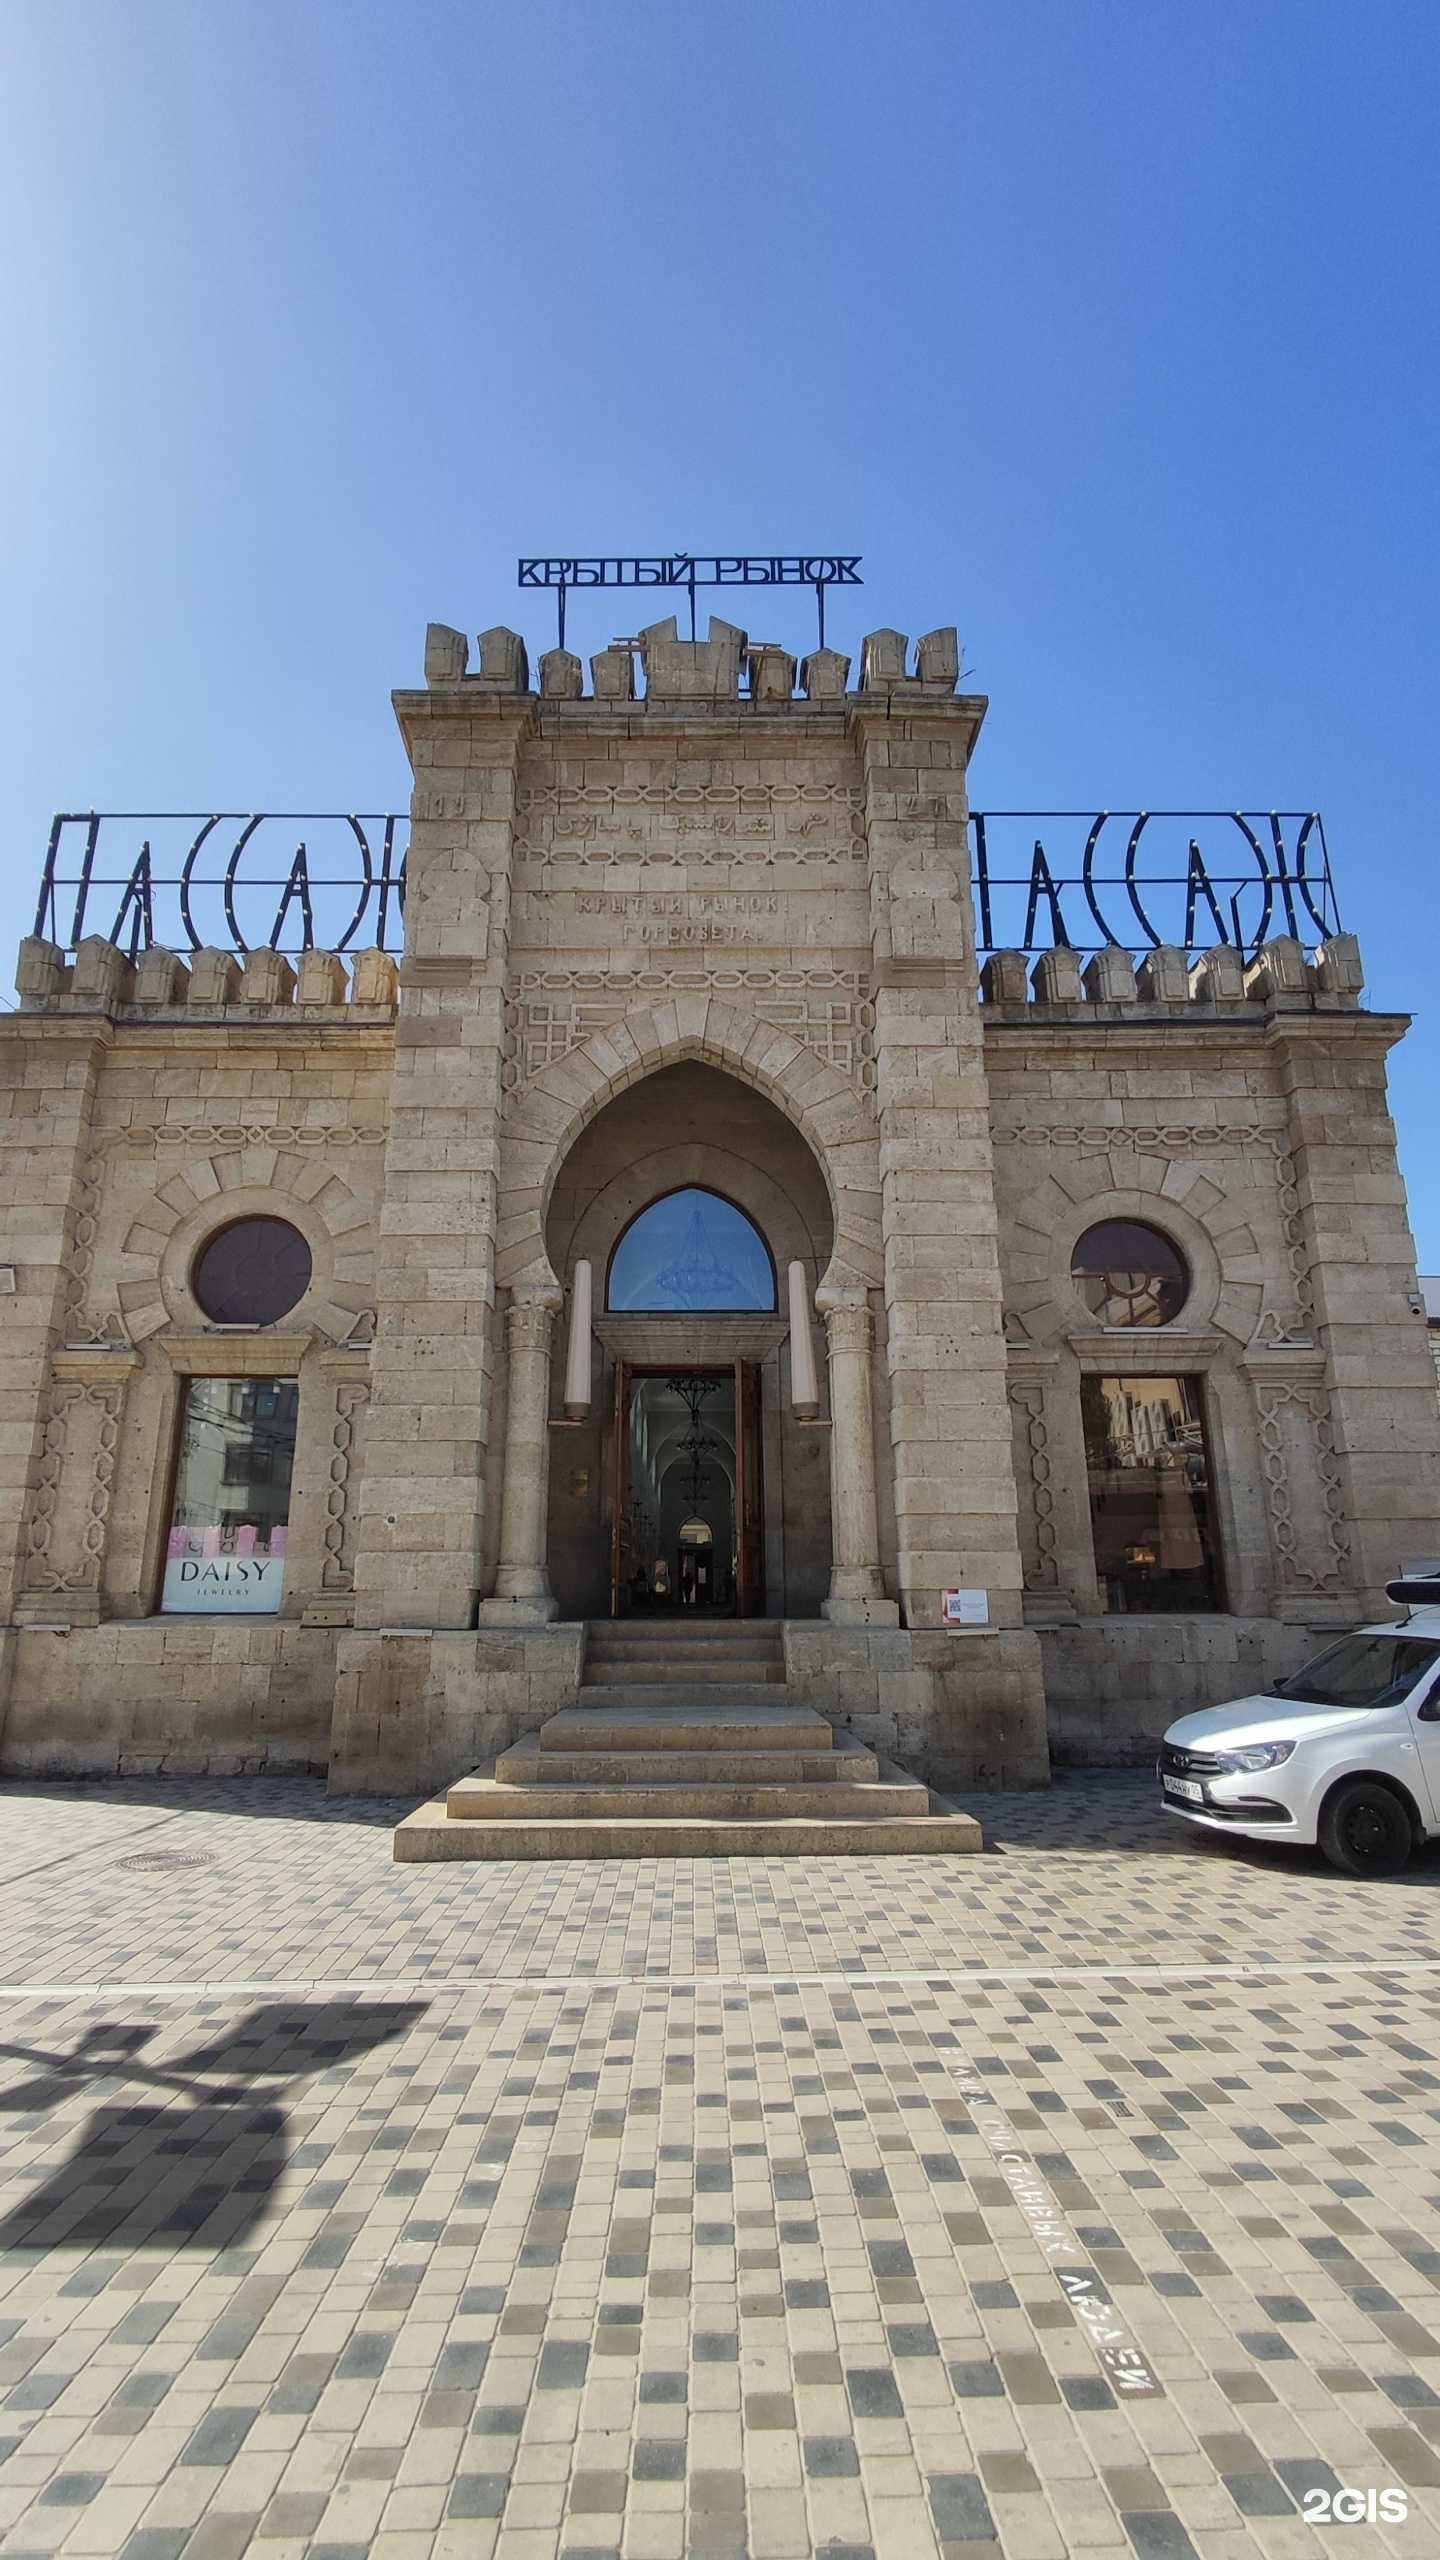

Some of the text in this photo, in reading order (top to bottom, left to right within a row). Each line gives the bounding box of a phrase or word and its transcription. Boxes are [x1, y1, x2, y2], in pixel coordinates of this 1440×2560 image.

[519, 552, 865, 587] КРЫТЫЙ РЫНОК
[33, 812, 407, 952] ПАССАЖ
[180, 1560, 271, 1582] DAISY
[196, 1588, 249, 1597] JEWELRY
